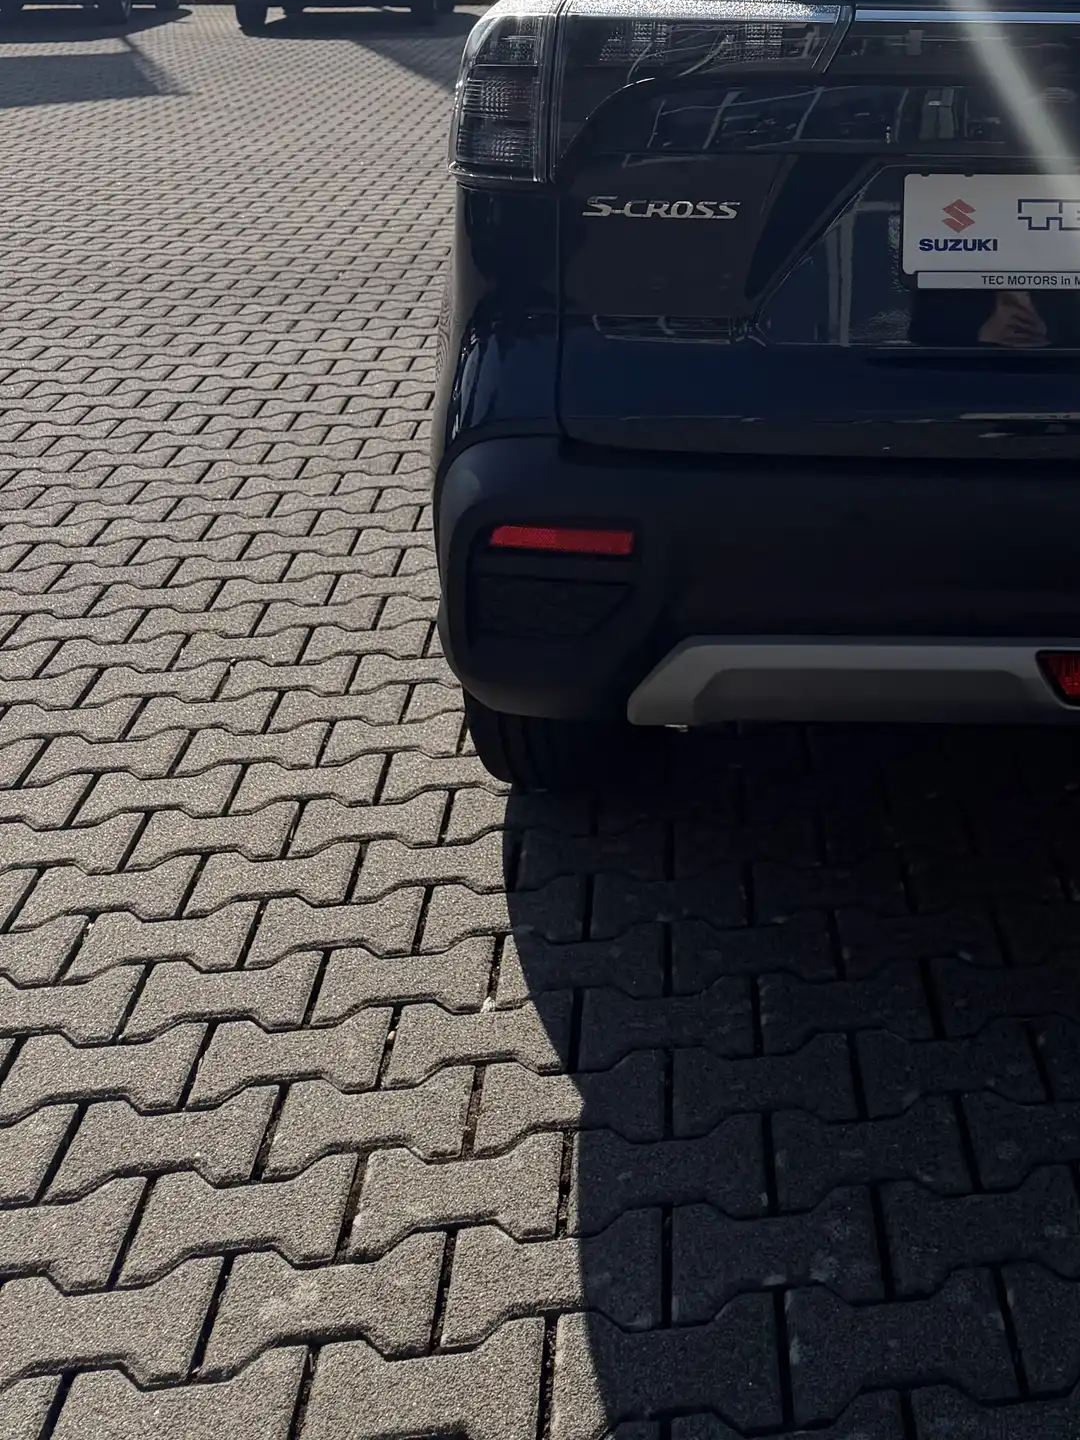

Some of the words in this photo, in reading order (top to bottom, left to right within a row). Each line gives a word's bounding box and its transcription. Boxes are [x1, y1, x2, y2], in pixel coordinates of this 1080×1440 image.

[582, 195, 741, 220] S-CROSS
[919, 238, 998, 252] SUZUKI
[981, 275, 1004, 285] TEC
[1007, 275, 1058, 286] MOTORS
